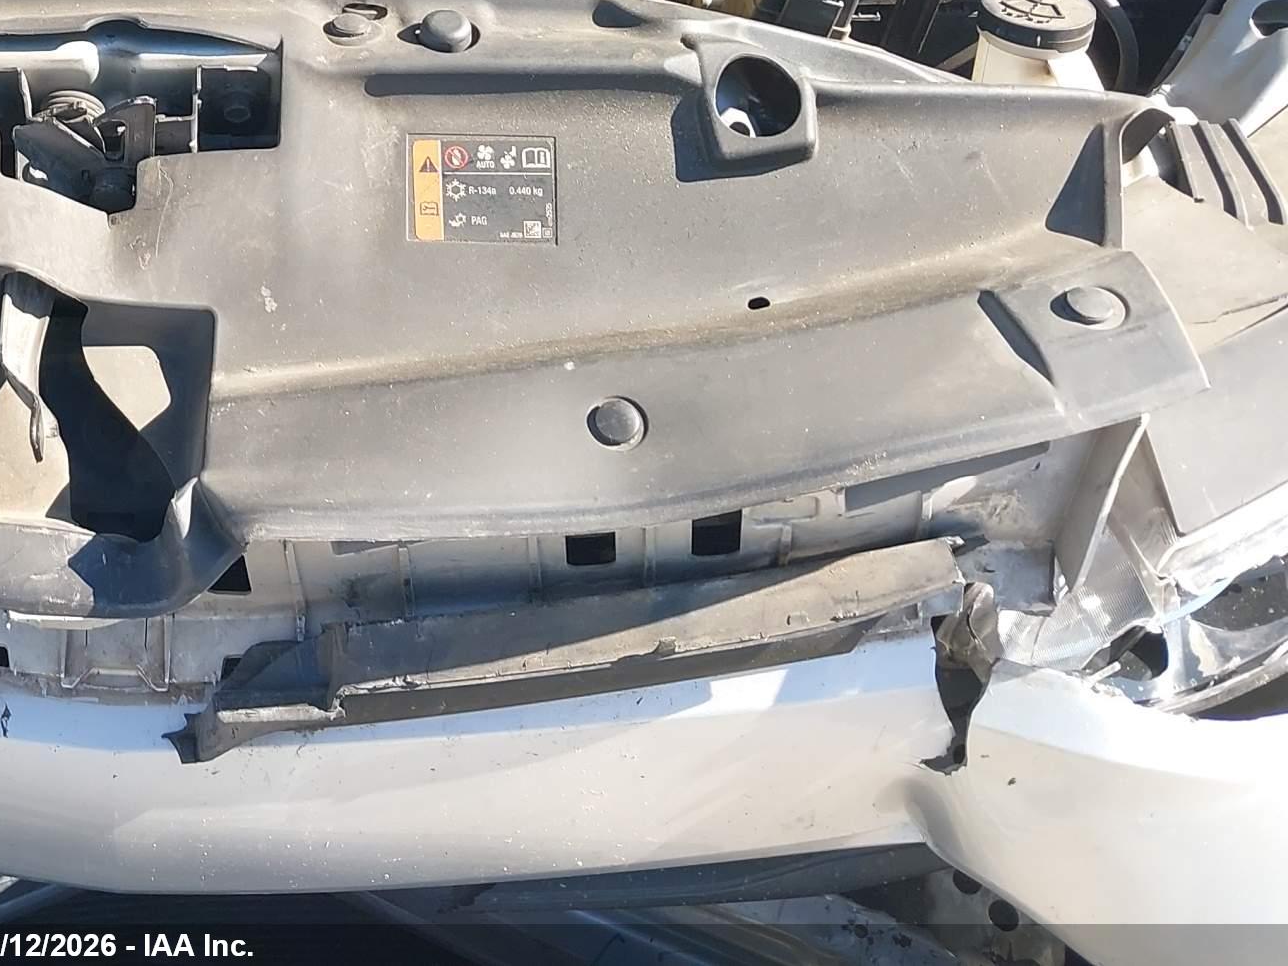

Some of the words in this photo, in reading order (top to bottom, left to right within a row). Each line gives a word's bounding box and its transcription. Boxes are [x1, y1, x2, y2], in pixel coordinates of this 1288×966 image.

[476, 160, 495, 169] AUTO
[468, 185, 497, 196] R-134a
[509, 186, 531, 195] 0.440
[533, 186, 543, 197] kg
[471, 216, 488, 226] PAG
